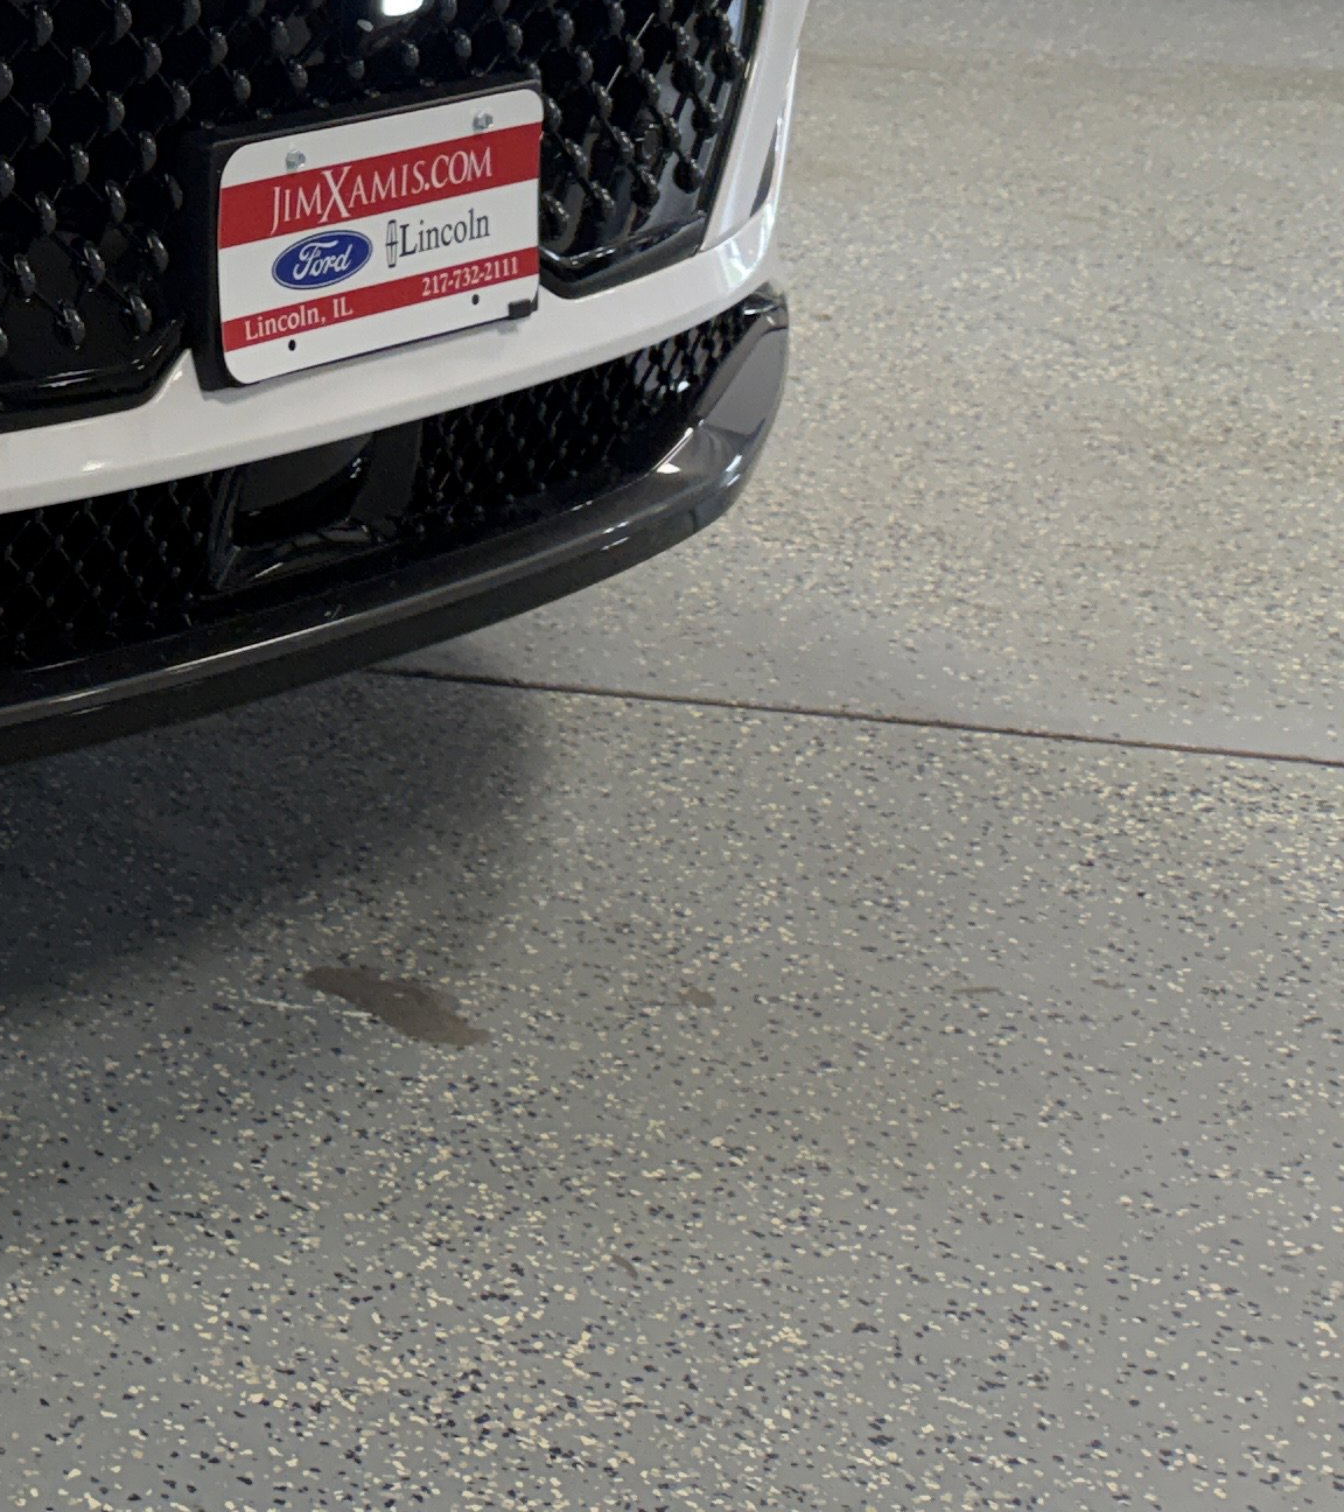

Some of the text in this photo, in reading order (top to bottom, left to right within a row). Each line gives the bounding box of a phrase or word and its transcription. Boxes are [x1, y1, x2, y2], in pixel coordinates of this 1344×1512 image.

[270, 146, 493, 236] JIMXAMIS.COM
[398, 207, 491, 258] Lincoln
[291, 240, 353, 281] Ford
[421, 257, 520, 298] 217-732-2111
[244, 295, 354, 342] Lincoln, IL
